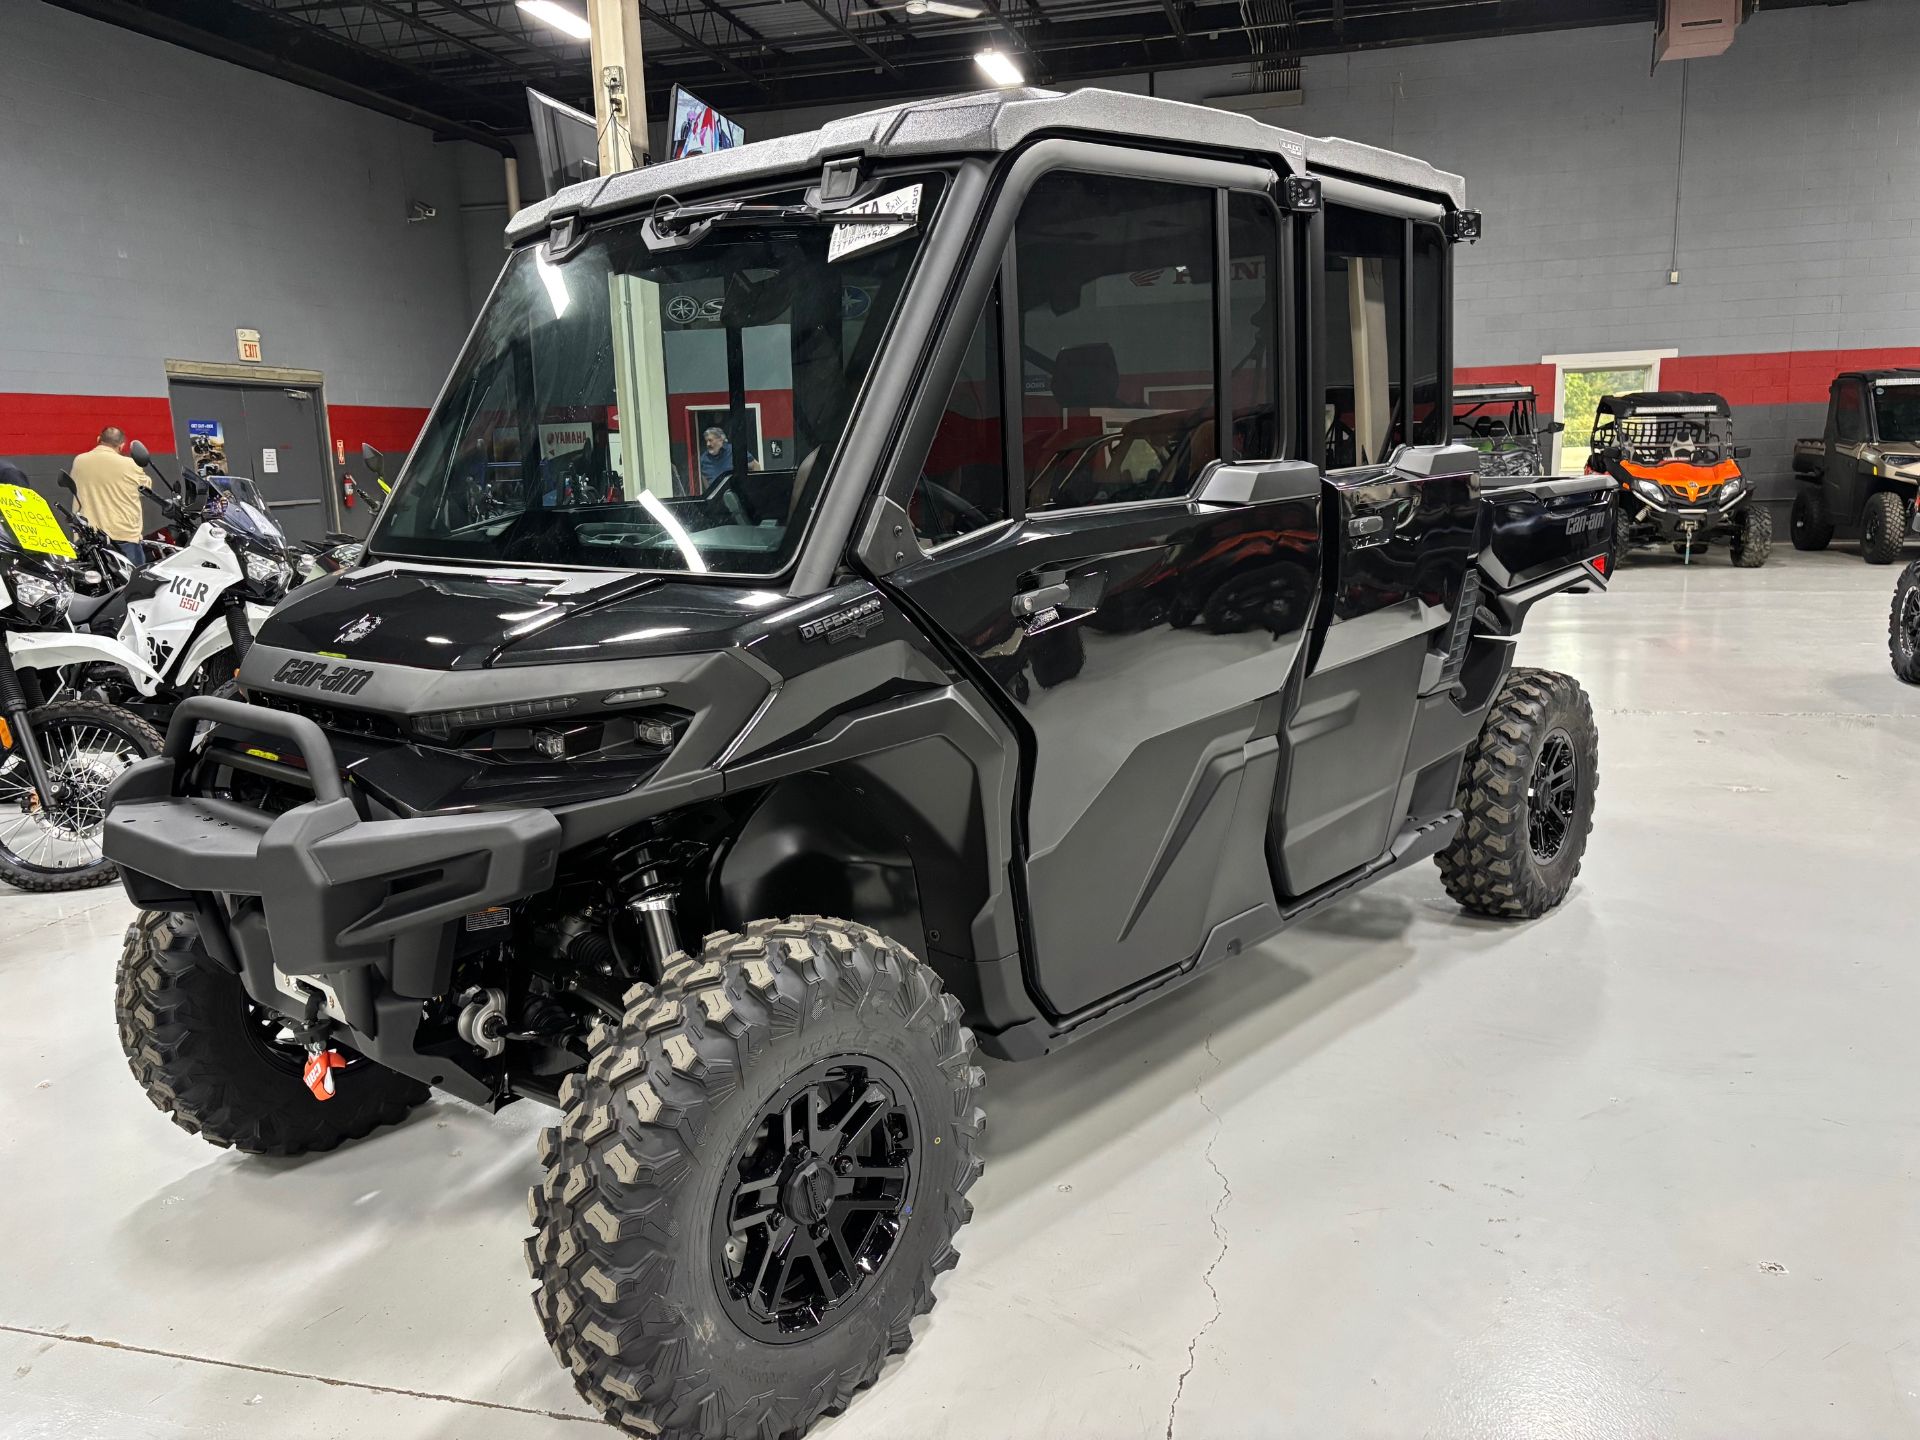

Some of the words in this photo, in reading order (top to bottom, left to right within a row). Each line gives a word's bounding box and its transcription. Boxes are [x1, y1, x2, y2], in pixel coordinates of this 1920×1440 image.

[244, 344, 258, 358] EXIT
[554, 431, 586, 444] YAMAHA
[13, 523, 37, 535] NOW
[1565, 511, 1606, 536] can-am
[169, 575, 209, 603] KLR
[179, 597, 200, 612] 650
[802, 597, 881, 639] DEFENDER
[273, 658, 375, 695] can-am
